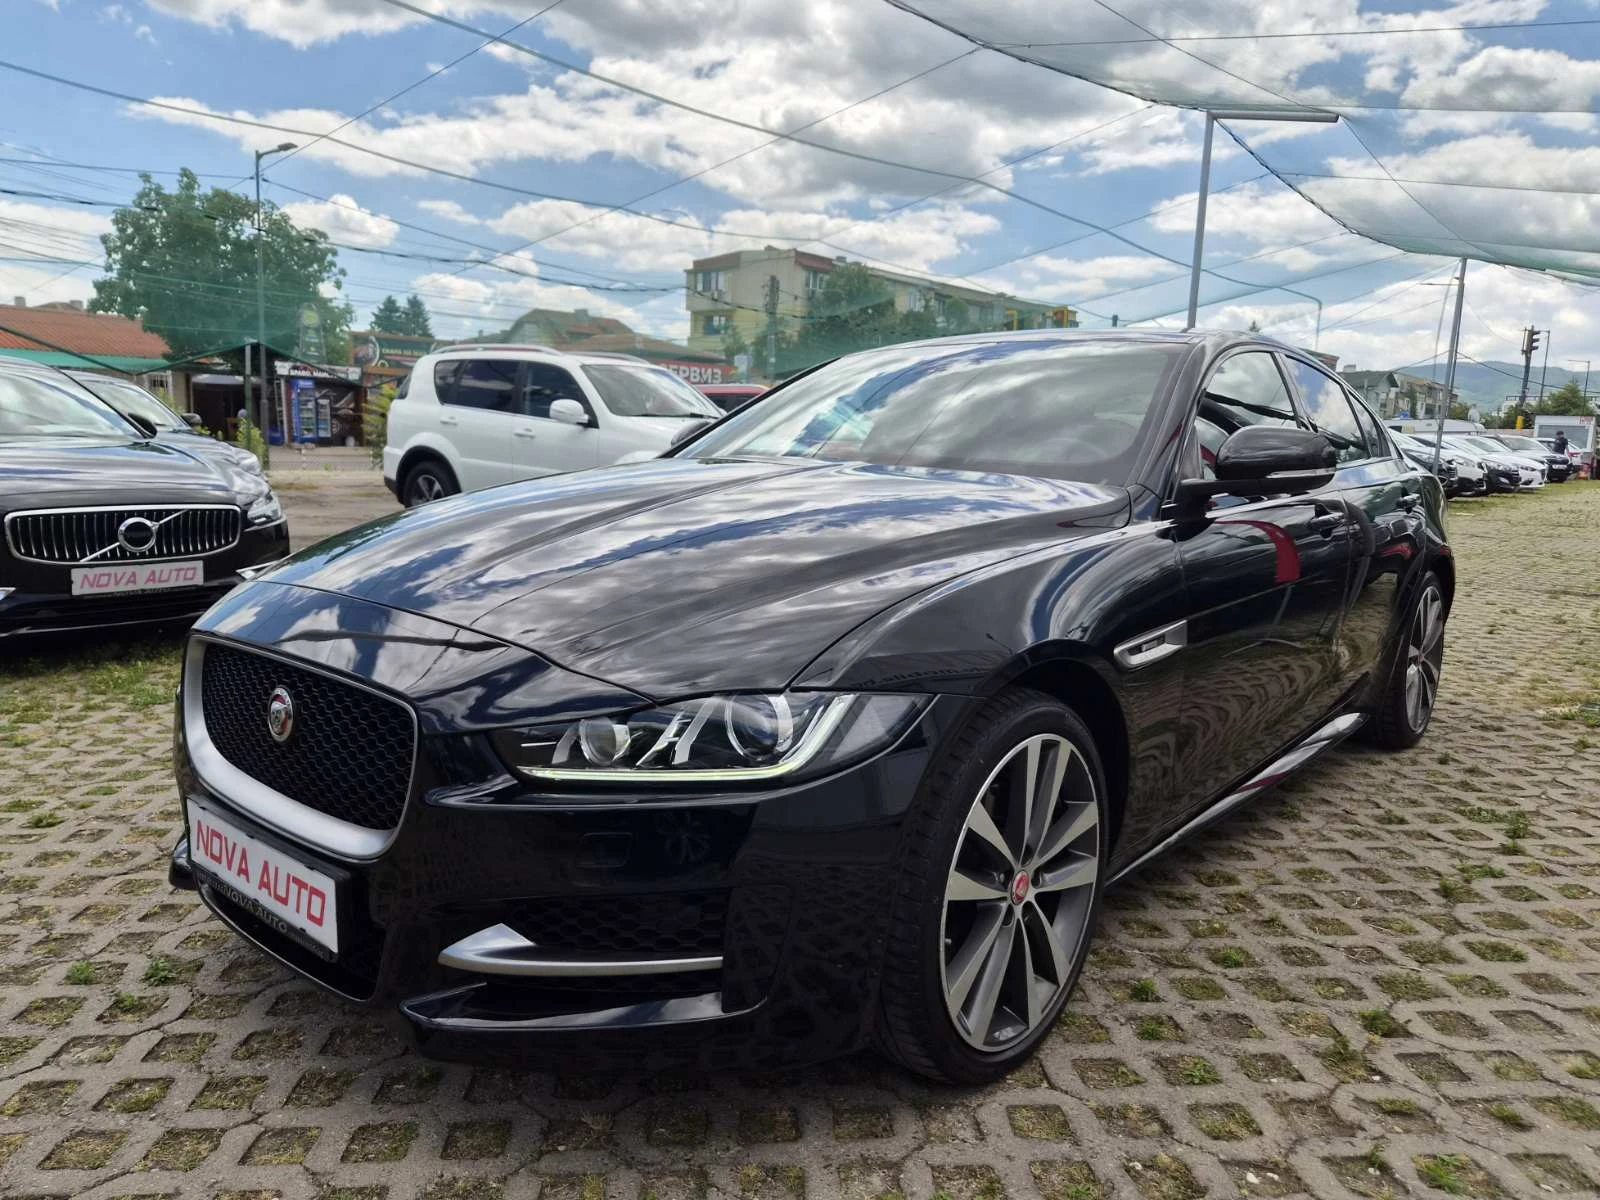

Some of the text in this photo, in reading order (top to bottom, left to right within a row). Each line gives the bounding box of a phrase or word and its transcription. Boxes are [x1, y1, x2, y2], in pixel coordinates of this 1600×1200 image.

[80, 567, 197, 589] NOVA AUTO
[196, 819, 326, 927] NOVA AUTO
[256, 908, 288, 933] AUTO
